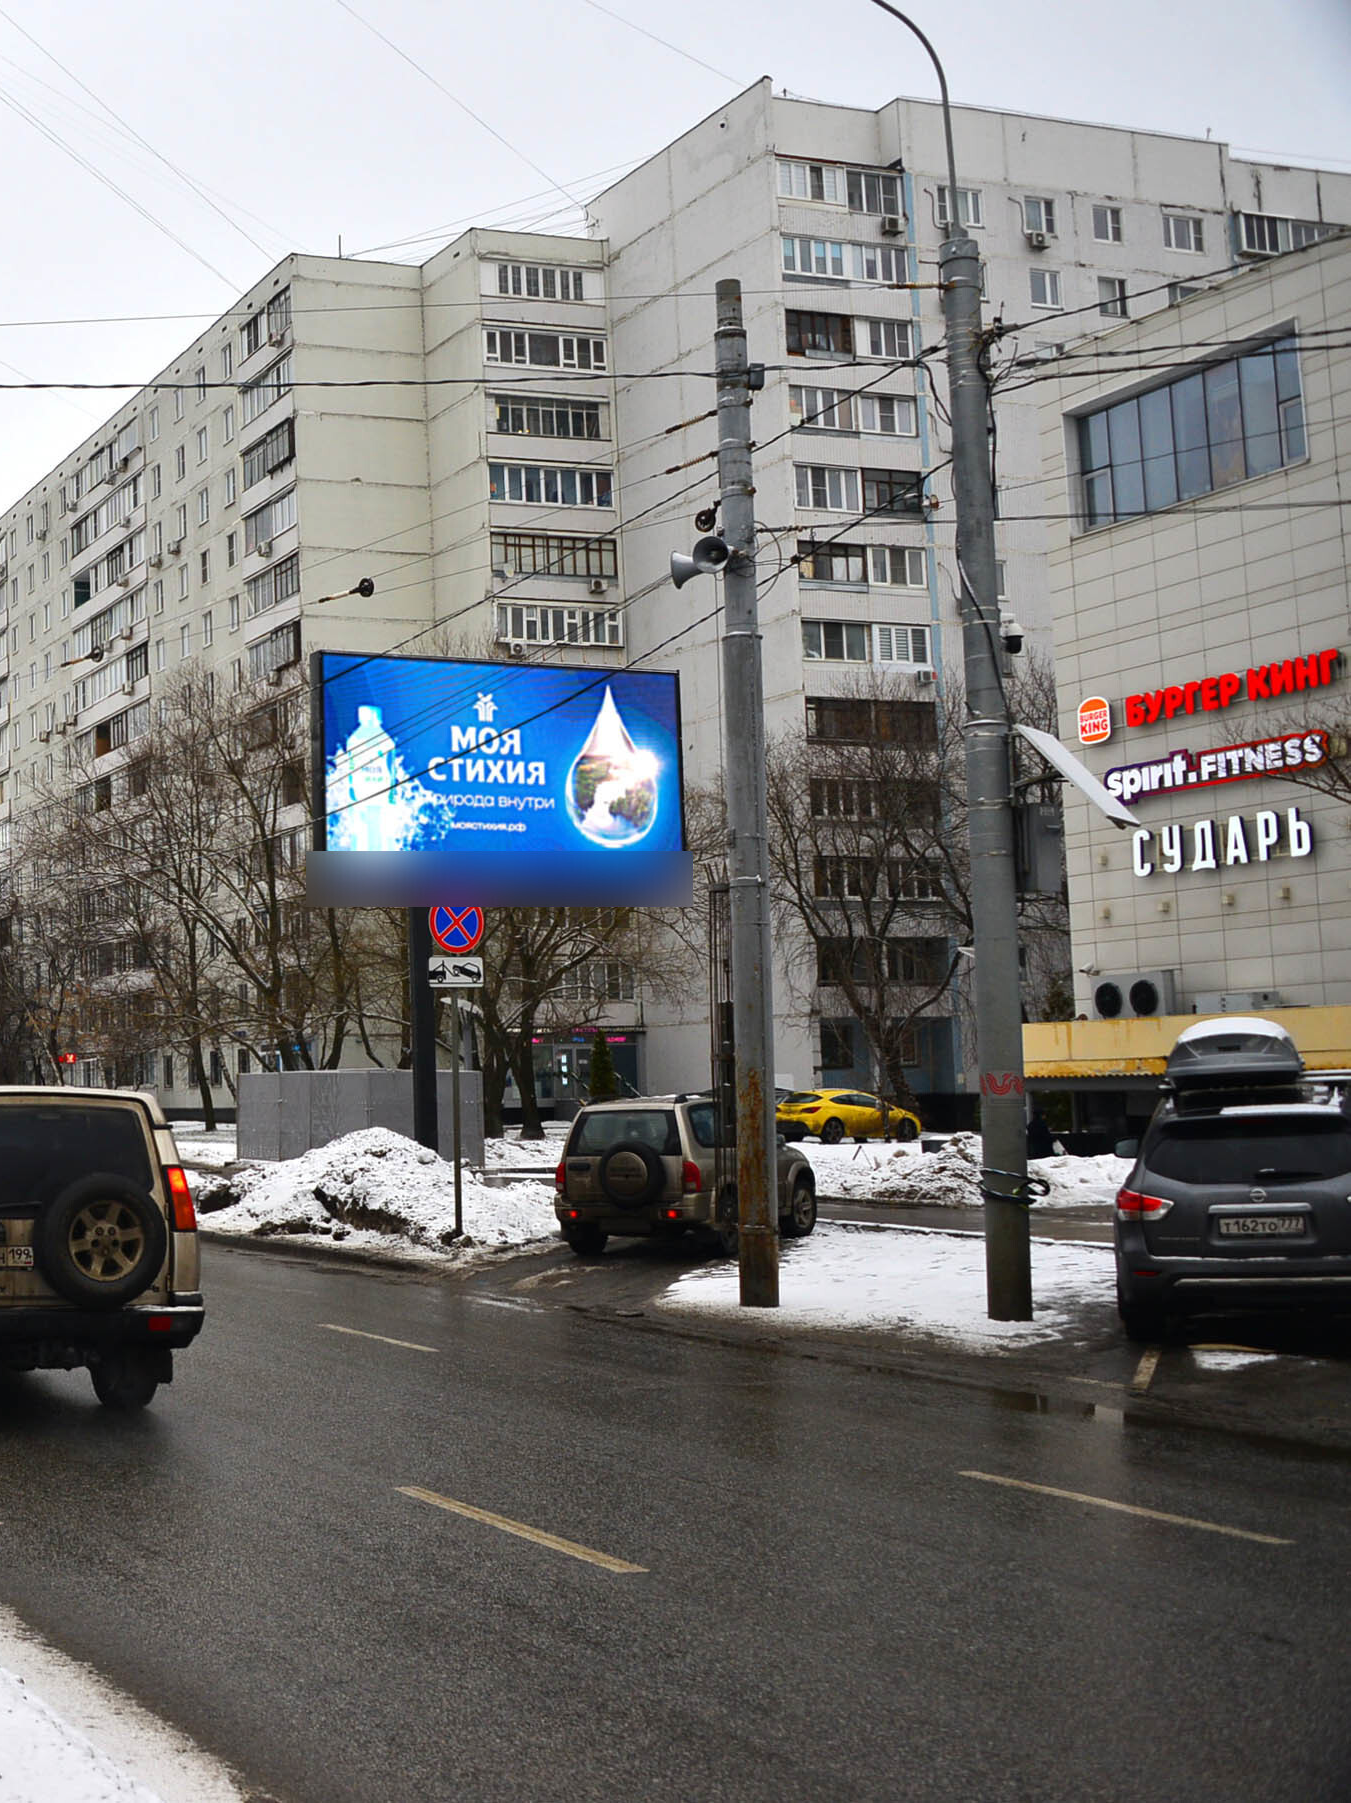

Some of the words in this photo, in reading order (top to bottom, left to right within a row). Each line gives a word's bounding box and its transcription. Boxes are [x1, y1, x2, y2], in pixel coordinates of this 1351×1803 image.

[1125, 672, 1241, 728] БУРГЕР
[1246, 648, 1339, 702] КИНГ
[1079, 709, 1108, 723] BURGER
[1080, 719, 1109, 735] KING
[450, 724, 522, 756] МОЯ
[427, 756, 547, 786] СТИХИЯ
[498, 796, 555, 811] внутри
[1132, 806, 1313, 878] СУДАРЬ
[1223, 1219, 1279, 1234] Т162ТО
[8, 1247, 30, 1260] 199
